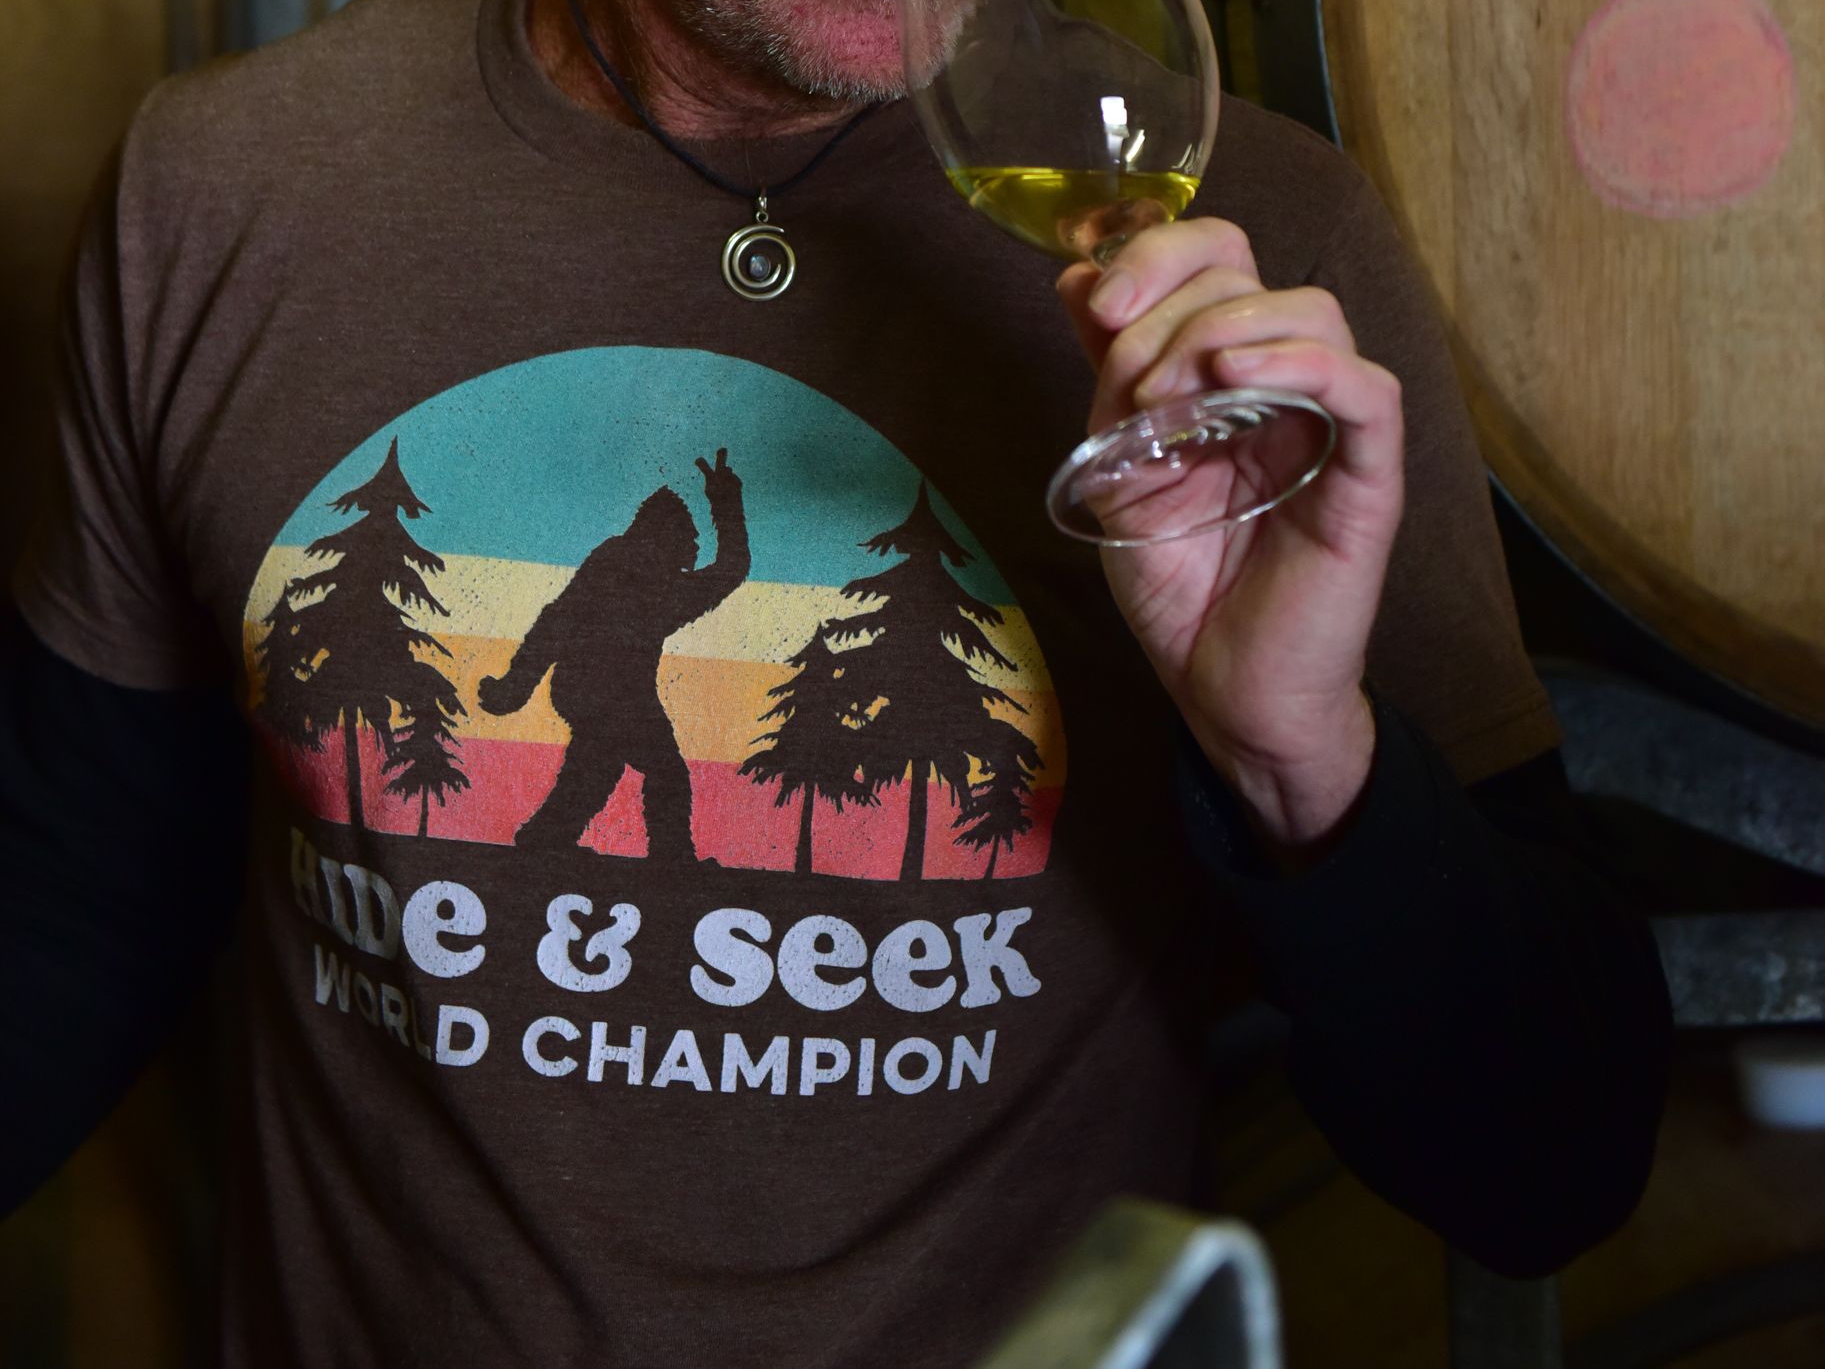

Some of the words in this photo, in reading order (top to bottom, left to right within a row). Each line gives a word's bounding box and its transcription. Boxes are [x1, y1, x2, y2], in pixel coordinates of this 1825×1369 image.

[535, 892, 642, 993] &
[312, 942, 491, 1068] WORLD
[521, 1014, 998, 1097] CHAMPION
